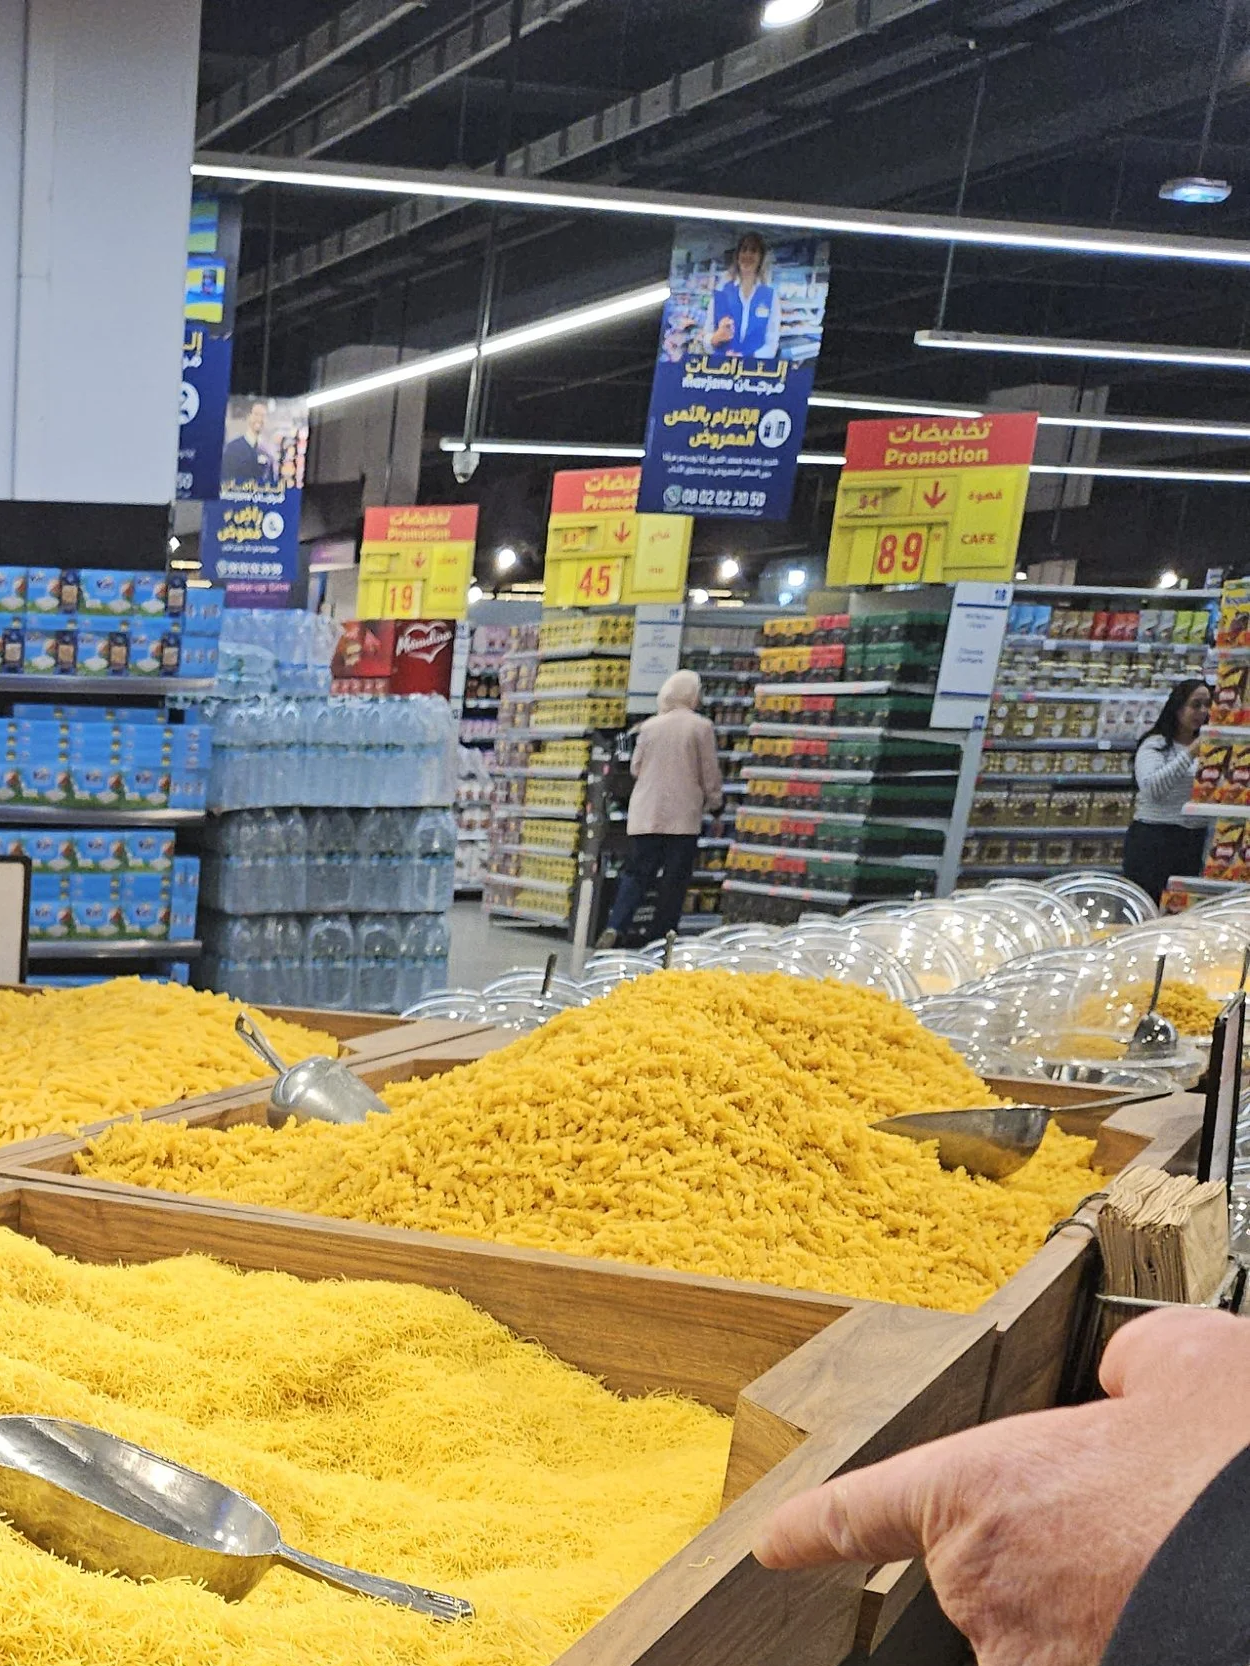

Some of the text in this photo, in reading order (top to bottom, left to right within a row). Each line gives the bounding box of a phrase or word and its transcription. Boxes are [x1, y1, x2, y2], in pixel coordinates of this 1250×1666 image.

[888, 421, 993, 446] تخفيضات
[884, 446, 989, 466] Promotion
[877, 532, 923, 575] 89
[579, 565, 612, 598] 45
[389, 584, 414, 614] 19
